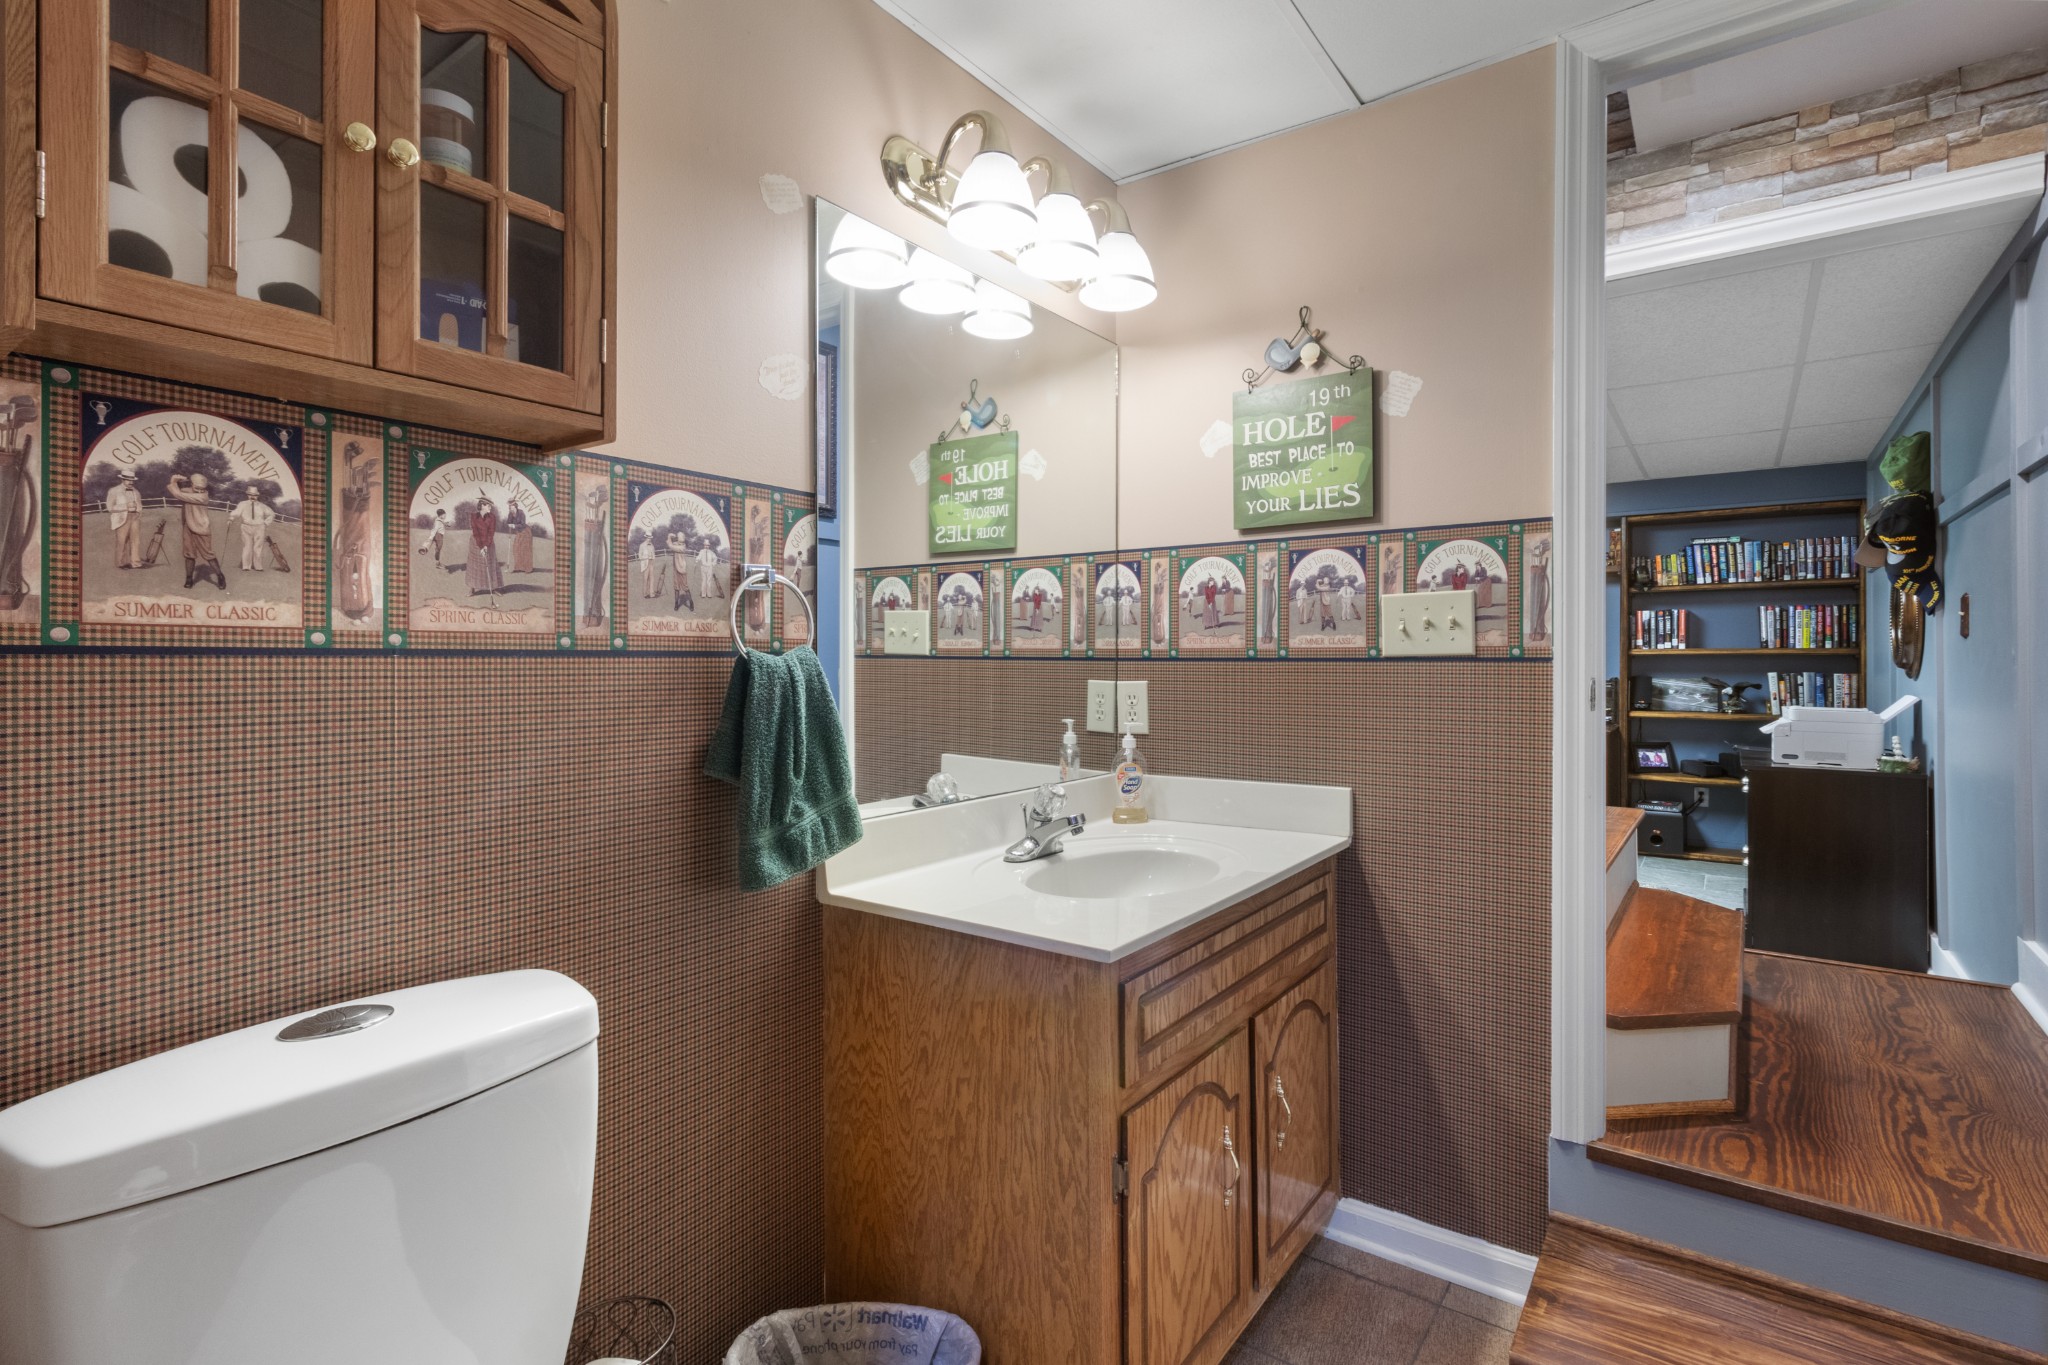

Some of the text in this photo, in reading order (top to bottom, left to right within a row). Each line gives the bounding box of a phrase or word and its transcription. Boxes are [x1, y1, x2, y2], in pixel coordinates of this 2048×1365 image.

[1309, 384, 1351, 407] 19th
[1242, 411, 1326, 446] HOLE
[111, 421, 279, 481] GOLF TOURNAMENT
[1248, 441, 1354, 468] BEST PLACE TO
[1241, 468, 1312, 491] IMPROVE
[424, 466, 544, 519] GOLF TOURNAMENT
[1246, 483, 1361, 514] YOUR LIES
[641, 498, 720, 535] GOLF TOURNAMENT
[790, 526, 806, 549] GOLF
[1424, 544, 1501, 574] GOLF TOURNAMENT
[114, 602, 277, 621] SUMMER CLASSIC
[429, 609, 528, 625] SPRING CLASSIC
[642, 620, 718, 633] SUMMER CLASSIC
[1297, 637, 1357, 646] SUMMER CLASSIC
